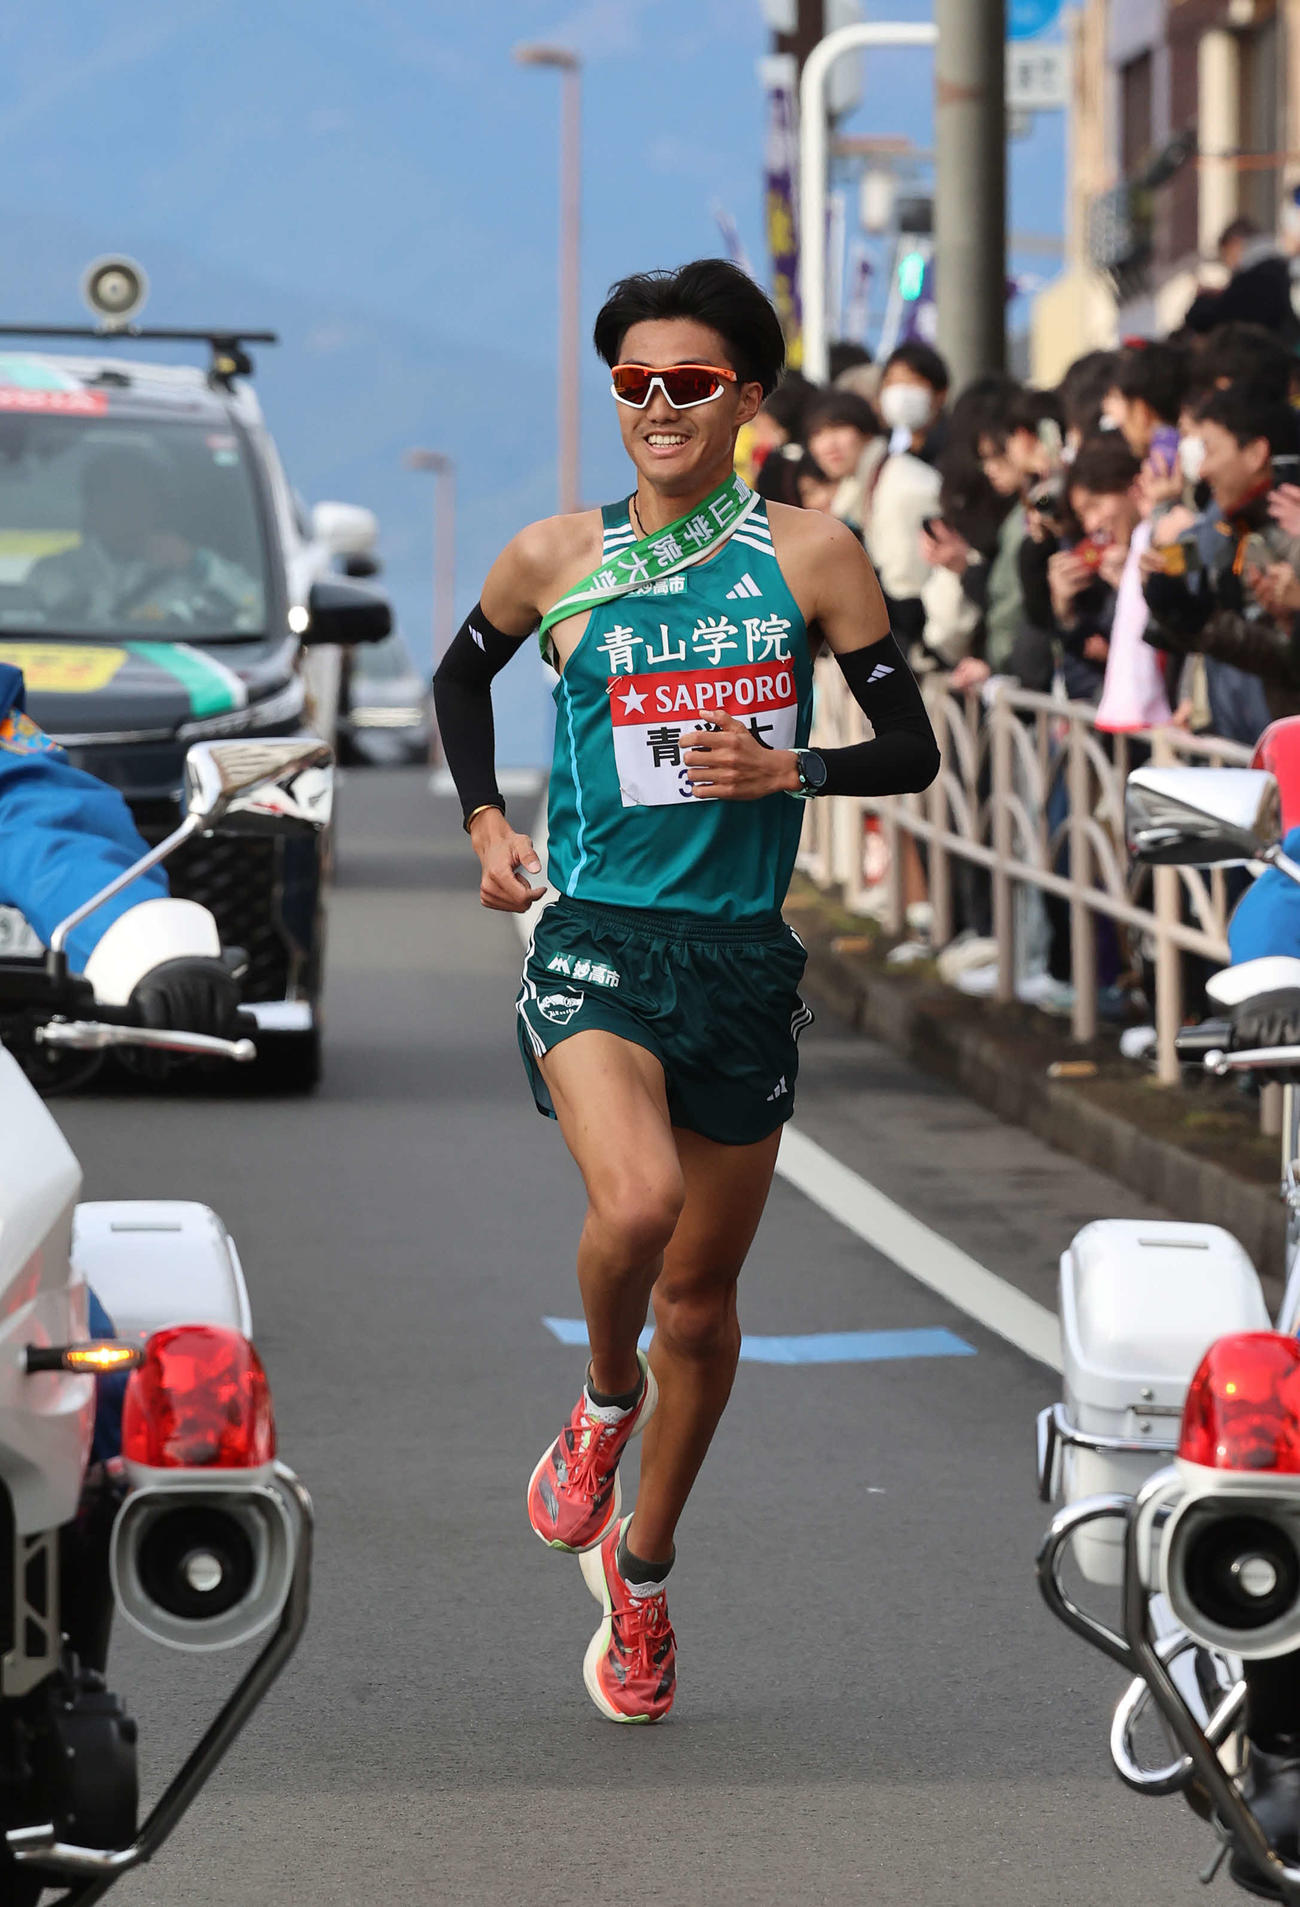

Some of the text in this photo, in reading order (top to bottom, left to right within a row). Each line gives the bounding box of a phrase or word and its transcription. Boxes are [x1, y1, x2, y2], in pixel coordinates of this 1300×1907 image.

[597, 613, 793, 674] 青山学院
[655, 671, 792, 713] SAPPORO
